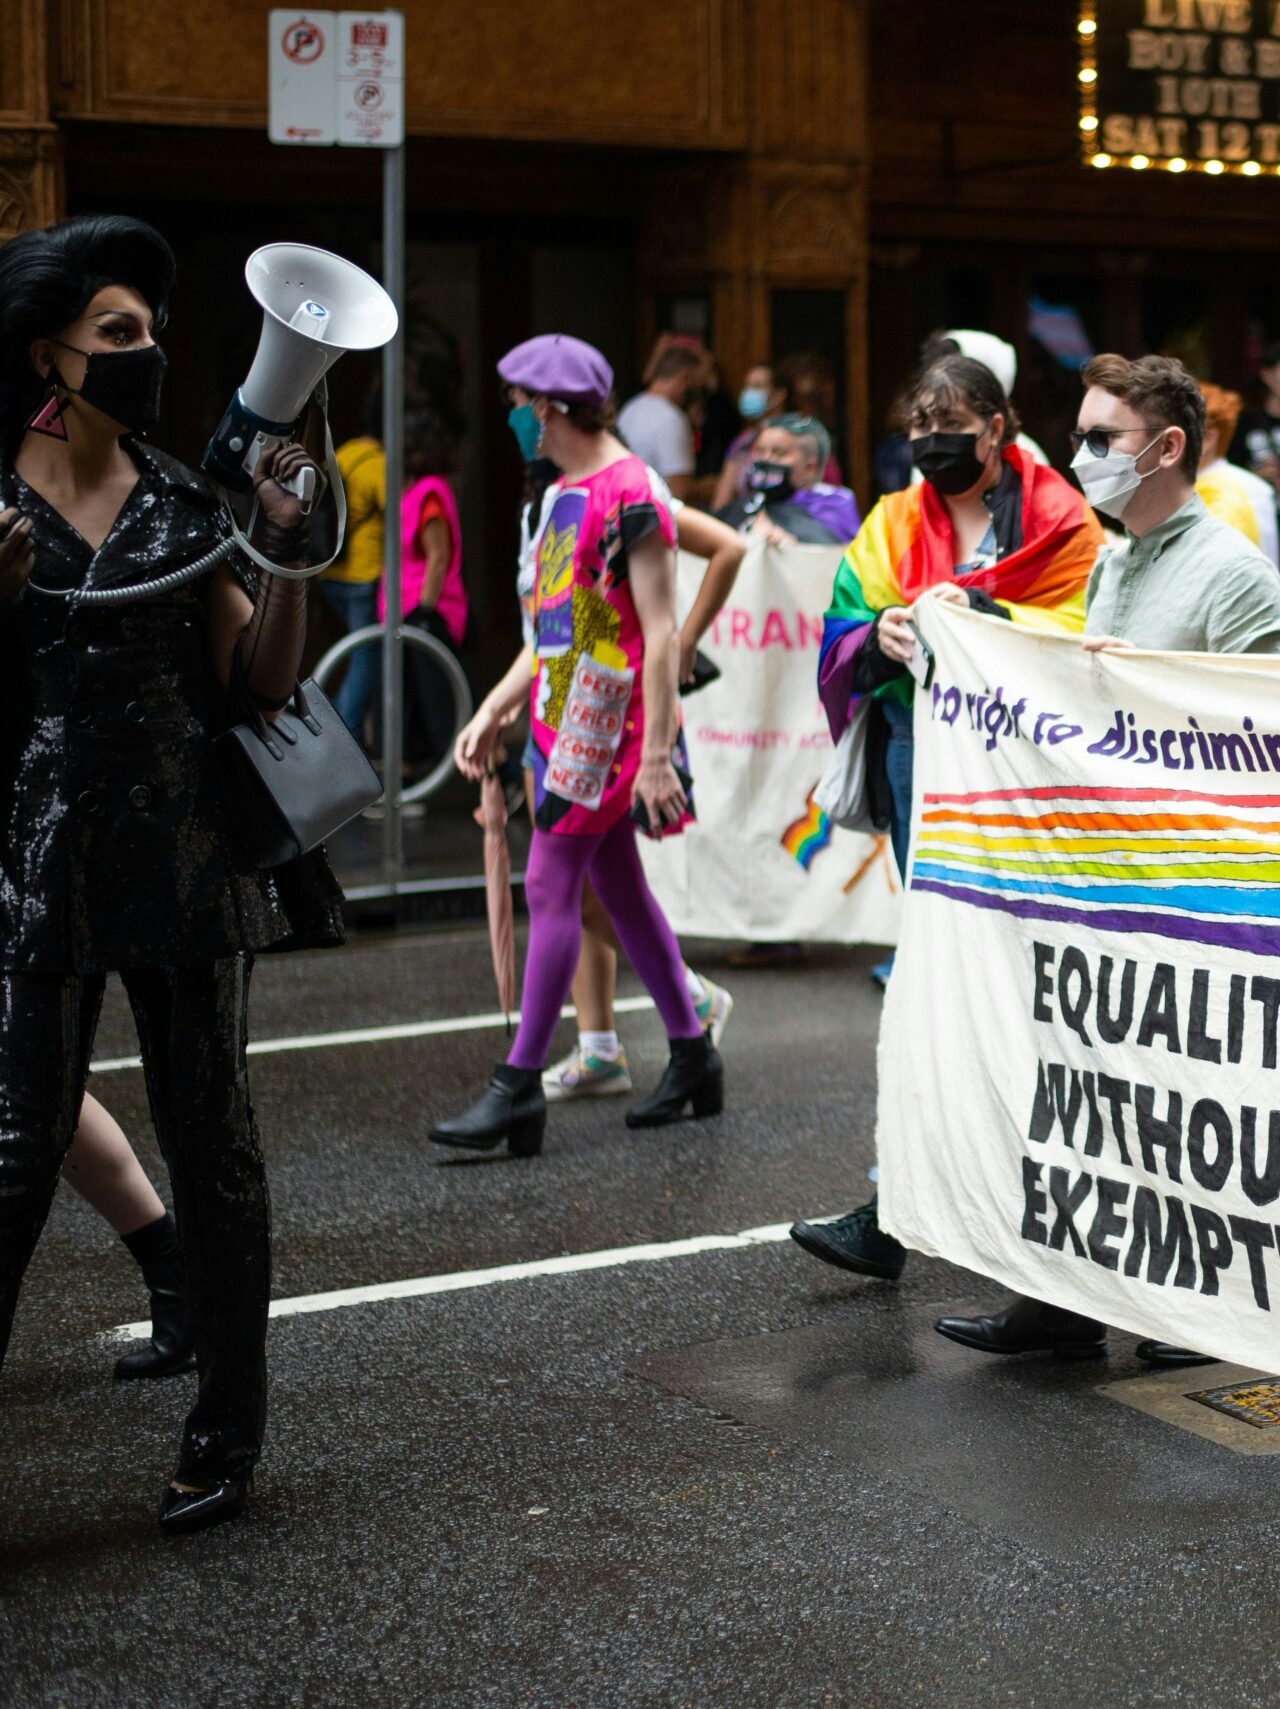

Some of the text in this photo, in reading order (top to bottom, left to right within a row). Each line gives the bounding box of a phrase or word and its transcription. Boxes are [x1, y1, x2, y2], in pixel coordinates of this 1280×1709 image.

[1143, 0, 1251, 34] LIVE
[1128, 30, 1210, 72] BOY
[1157, 76, 1262, 119] 10TH
[1103, 115, 1187, 155] SAT
[712, 608, 823, 651] TRAN
[966, 687, 1029, 751] right
[1034, 712, 1083, 746] to
